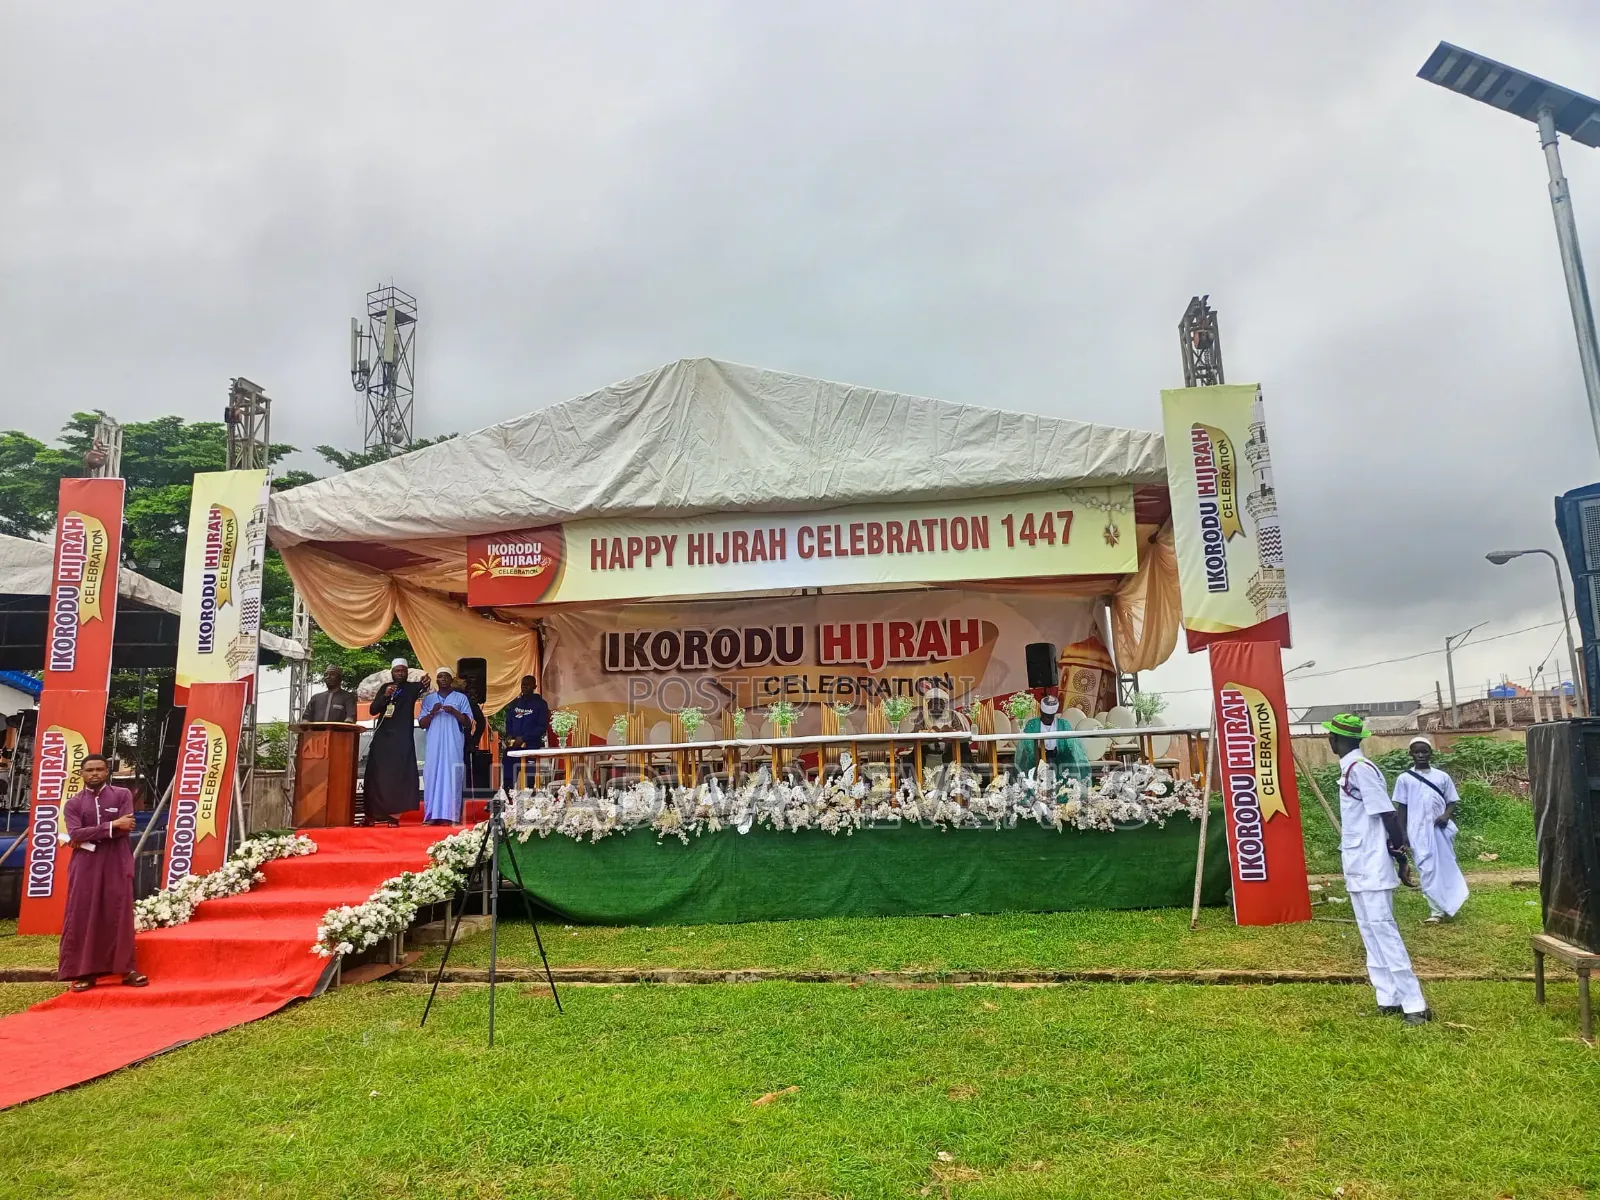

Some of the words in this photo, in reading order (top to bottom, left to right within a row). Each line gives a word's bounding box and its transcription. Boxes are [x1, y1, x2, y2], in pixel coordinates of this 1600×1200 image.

[1191, 428, 1219, 498] HIJRAH
[1217, 439, 1234, 519] CELEBRATION
[58, 516, 87, 581] HIJRAH
[84, 529, 103, 605] CELEBRATION
[204, 507, 222, 568] HIJRAH
[219, 518, 234, 589] CELEBRATION
[488, 542, 541, 556] IKORODU
[501, 554, 541, 568] HIJRAH
[590, 535, 678, 571] HAPPY
[687, 528, 787, 566] HIJRAH
[797, 515, 990, 559] CELEBRATION
[1001, 510, 1075, 548] 1447
[1201, 501, 1228, 592] IKORODU
[50, 585, 80, 671] IKORODU
[198, 573, 218, 654] IKORODU
[605, 624, 805, 671] IKORODU
[821, 617, 986, 673] HIJRAH
[763, 672, 954, 698] CELEBRATION
[180, 724, 209, 795] HIJRAH
[1219, 689, 1257, 769] HIJRAH
[1254, 702, 1275, 796] CELEBRATION
[37, 731, 68, 800] HIJRAH
[201, 737, 223, 820] CELEBRATION
[28, 805, 59, 897] IKORODU
[1229, 773, 1268, 881] IKORODU
